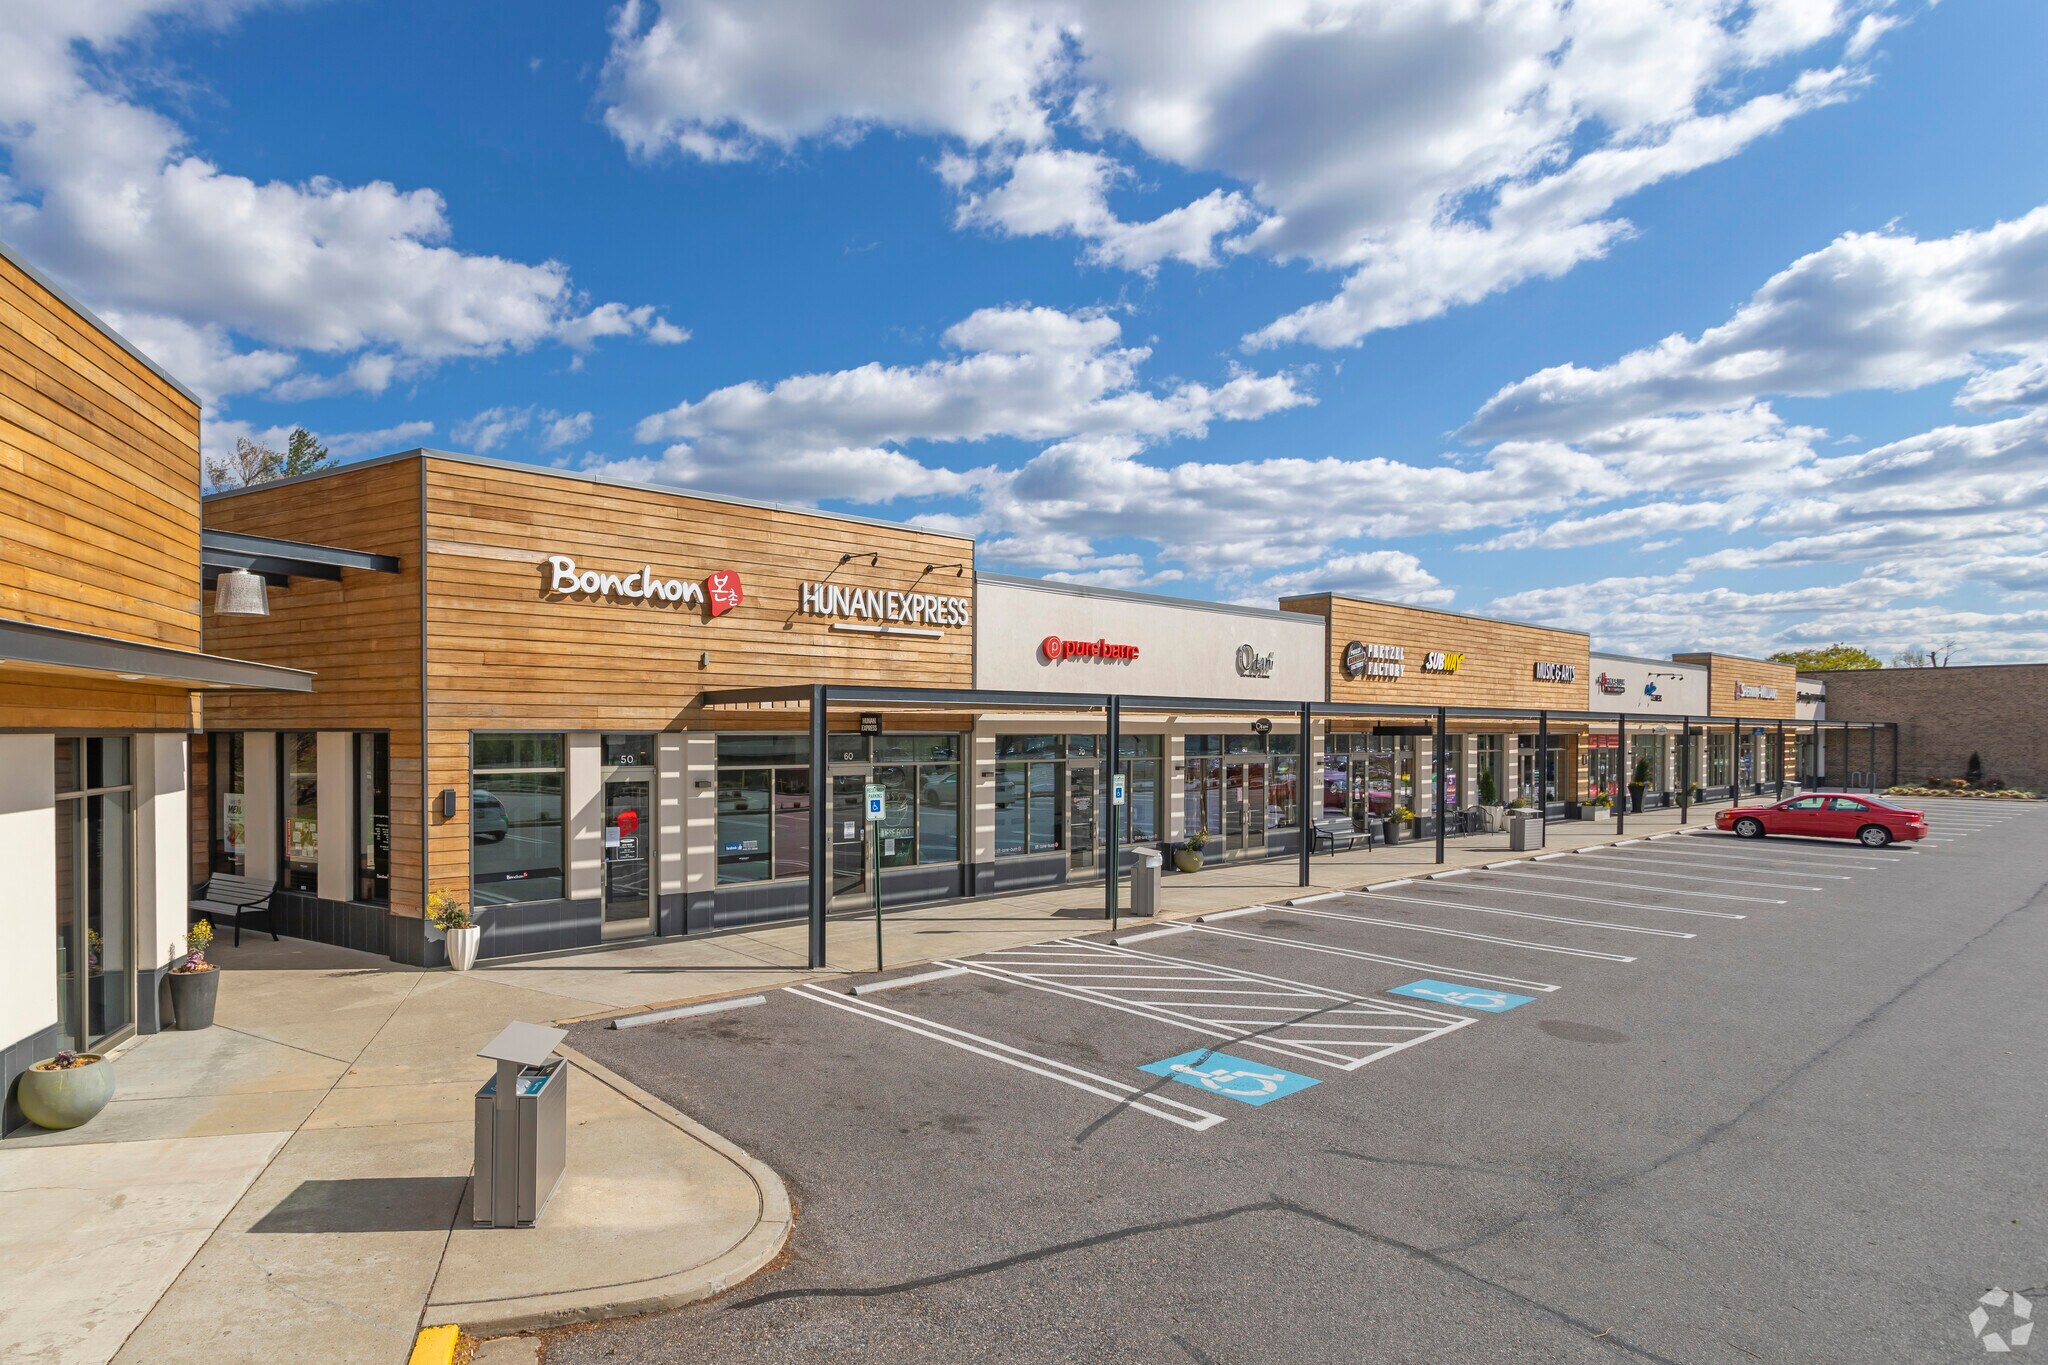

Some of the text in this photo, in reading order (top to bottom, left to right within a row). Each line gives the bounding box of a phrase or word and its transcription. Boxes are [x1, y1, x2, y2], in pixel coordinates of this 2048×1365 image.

[549, 555, 704, 604] Bonchon
[802, 582, 969, 626] HUNAN EXPRESS
[1367, 644, 1405, 660] PRETZEL
[1367, 661, 1405, 677] FACTORY
[1425, 651, 1465, 671] SUBWAY
[1536, 662, 1576, 681] MUSIC & ARTS
[861, 724, 878, 732] EXPRESS
[862, 717, 877, 725] HUNAN
[620, 755, 634, 764] 50
[843, 752, 854, 761] 60
